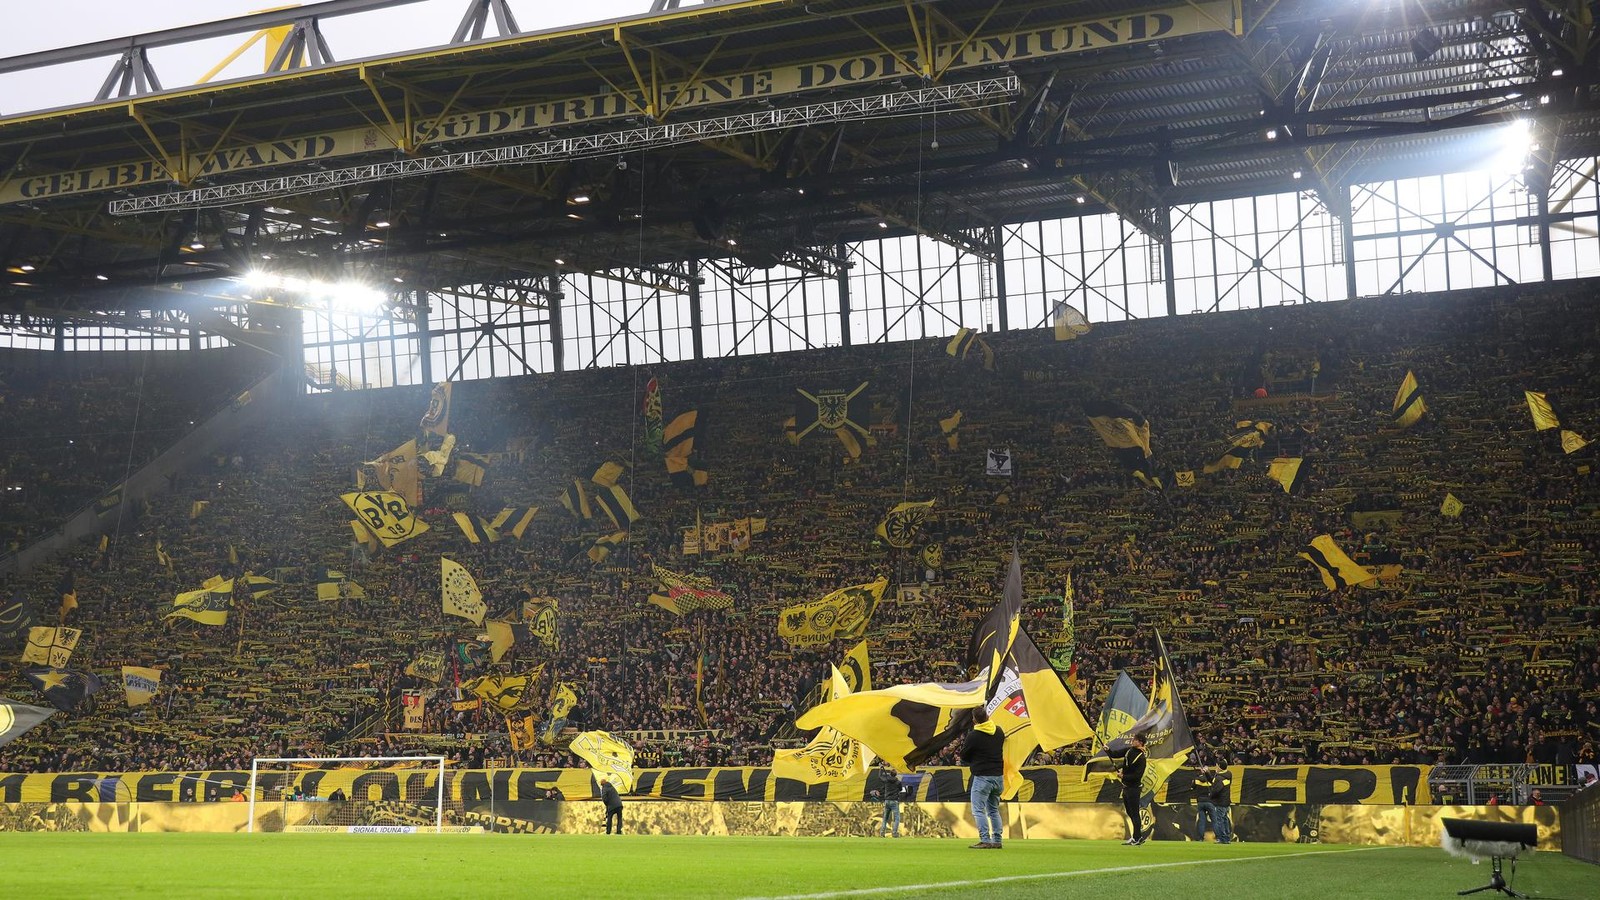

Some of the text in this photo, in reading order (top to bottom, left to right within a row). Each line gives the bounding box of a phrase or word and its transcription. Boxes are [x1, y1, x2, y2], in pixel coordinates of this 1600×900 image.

[20, 12, 1175, 198] GELBE WAND SÜDTRIBÜNE DORTMUND
[362, 494, 410, 530] BVB
[387, 523, 406, 534] 09
